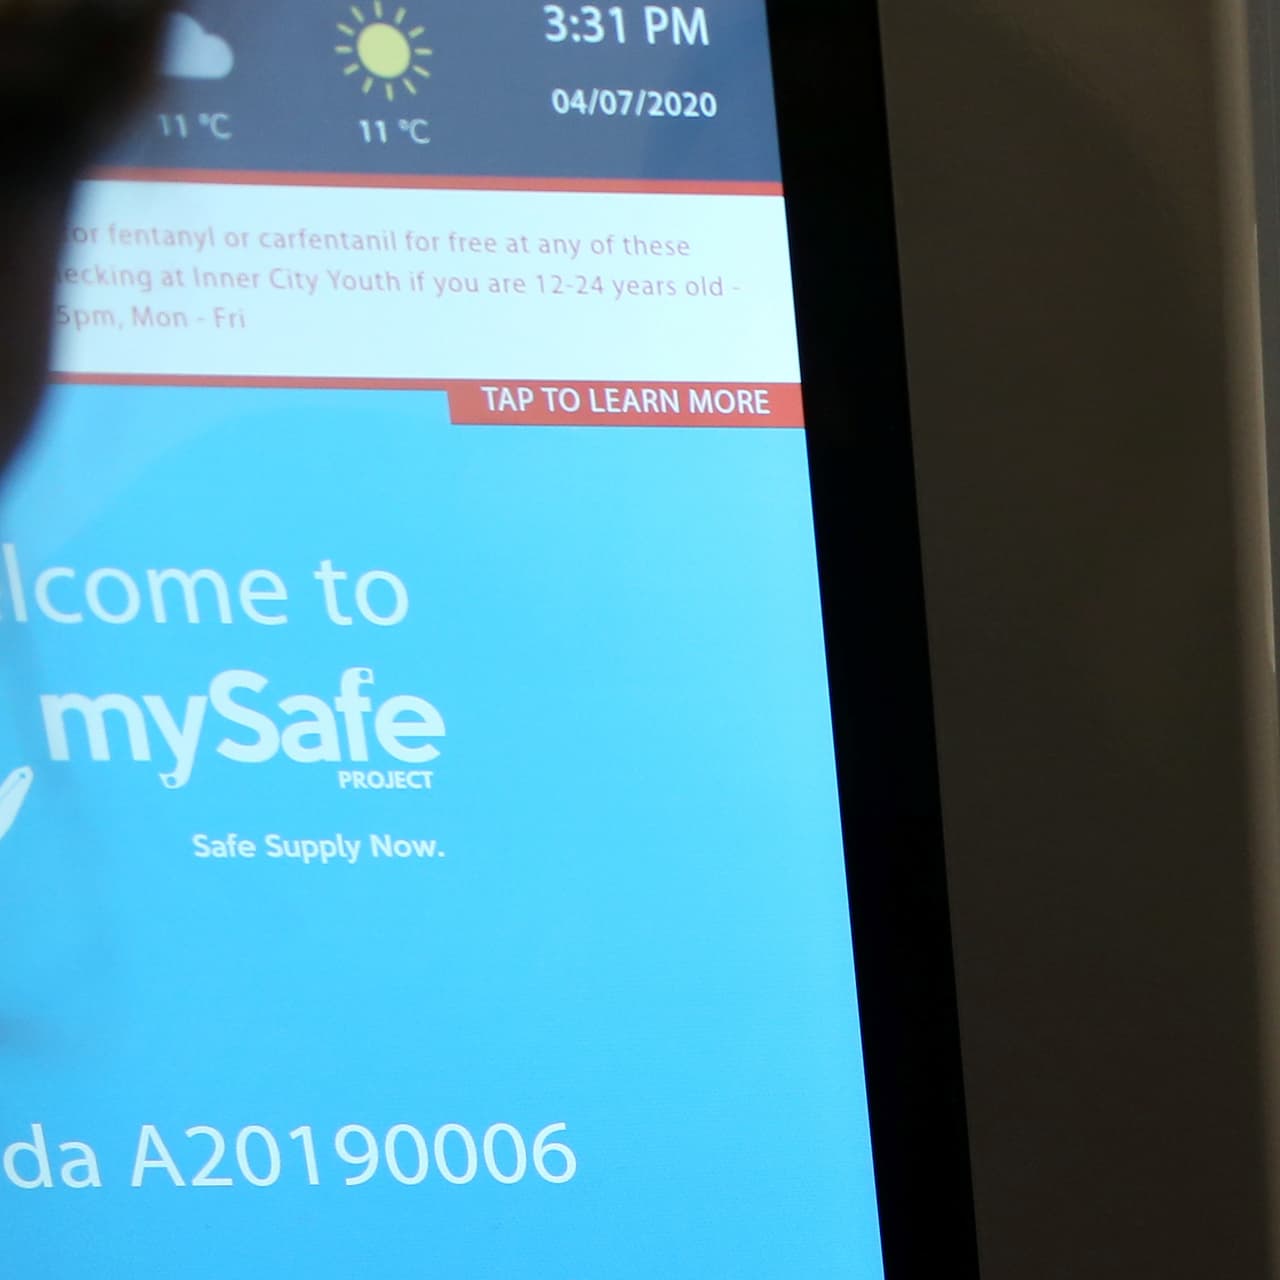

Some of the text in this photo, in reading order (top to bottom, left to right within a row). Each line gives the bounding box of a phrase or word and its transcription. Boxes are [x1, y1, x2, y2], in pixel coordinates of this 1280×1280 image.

[542, 4, 710, 46] 3:31 PM
[551, 87, 718, 118] 04/07/2020
[159, 113, 188, 139] 11
[358, 119, 388, 144] 11
[65, 223, 691, 260] or fentanyl or carfentanil for free at any of these
[160, 269, 185, 287] at
[193, 266, 261, 289] Inner
[268, 267, 319, 295] City
[327, 268, 401, 292] Youth
[409, 271, 425, 292] if
[433, 276, 480, 298] you
[487, 276, 527, 294] are
[536, 274, 605, 295] 12-24
[612, 278, 678, 300] years
[685, 276, 724, 297] old
[131, 306, 189, 329] Mon
[213, 307, 247, 329] Fri
[480, 385, 771, 415] TAP TO LEARN MORE
[312, 558, 410, 626] to
[39, 666, 447, 790] mySafe
[337, 770, 434, 790] PROJECT
[191, 832, 446, 865] Safe Supply Now.
[2, 1121, 579, 1189] da A20190006
